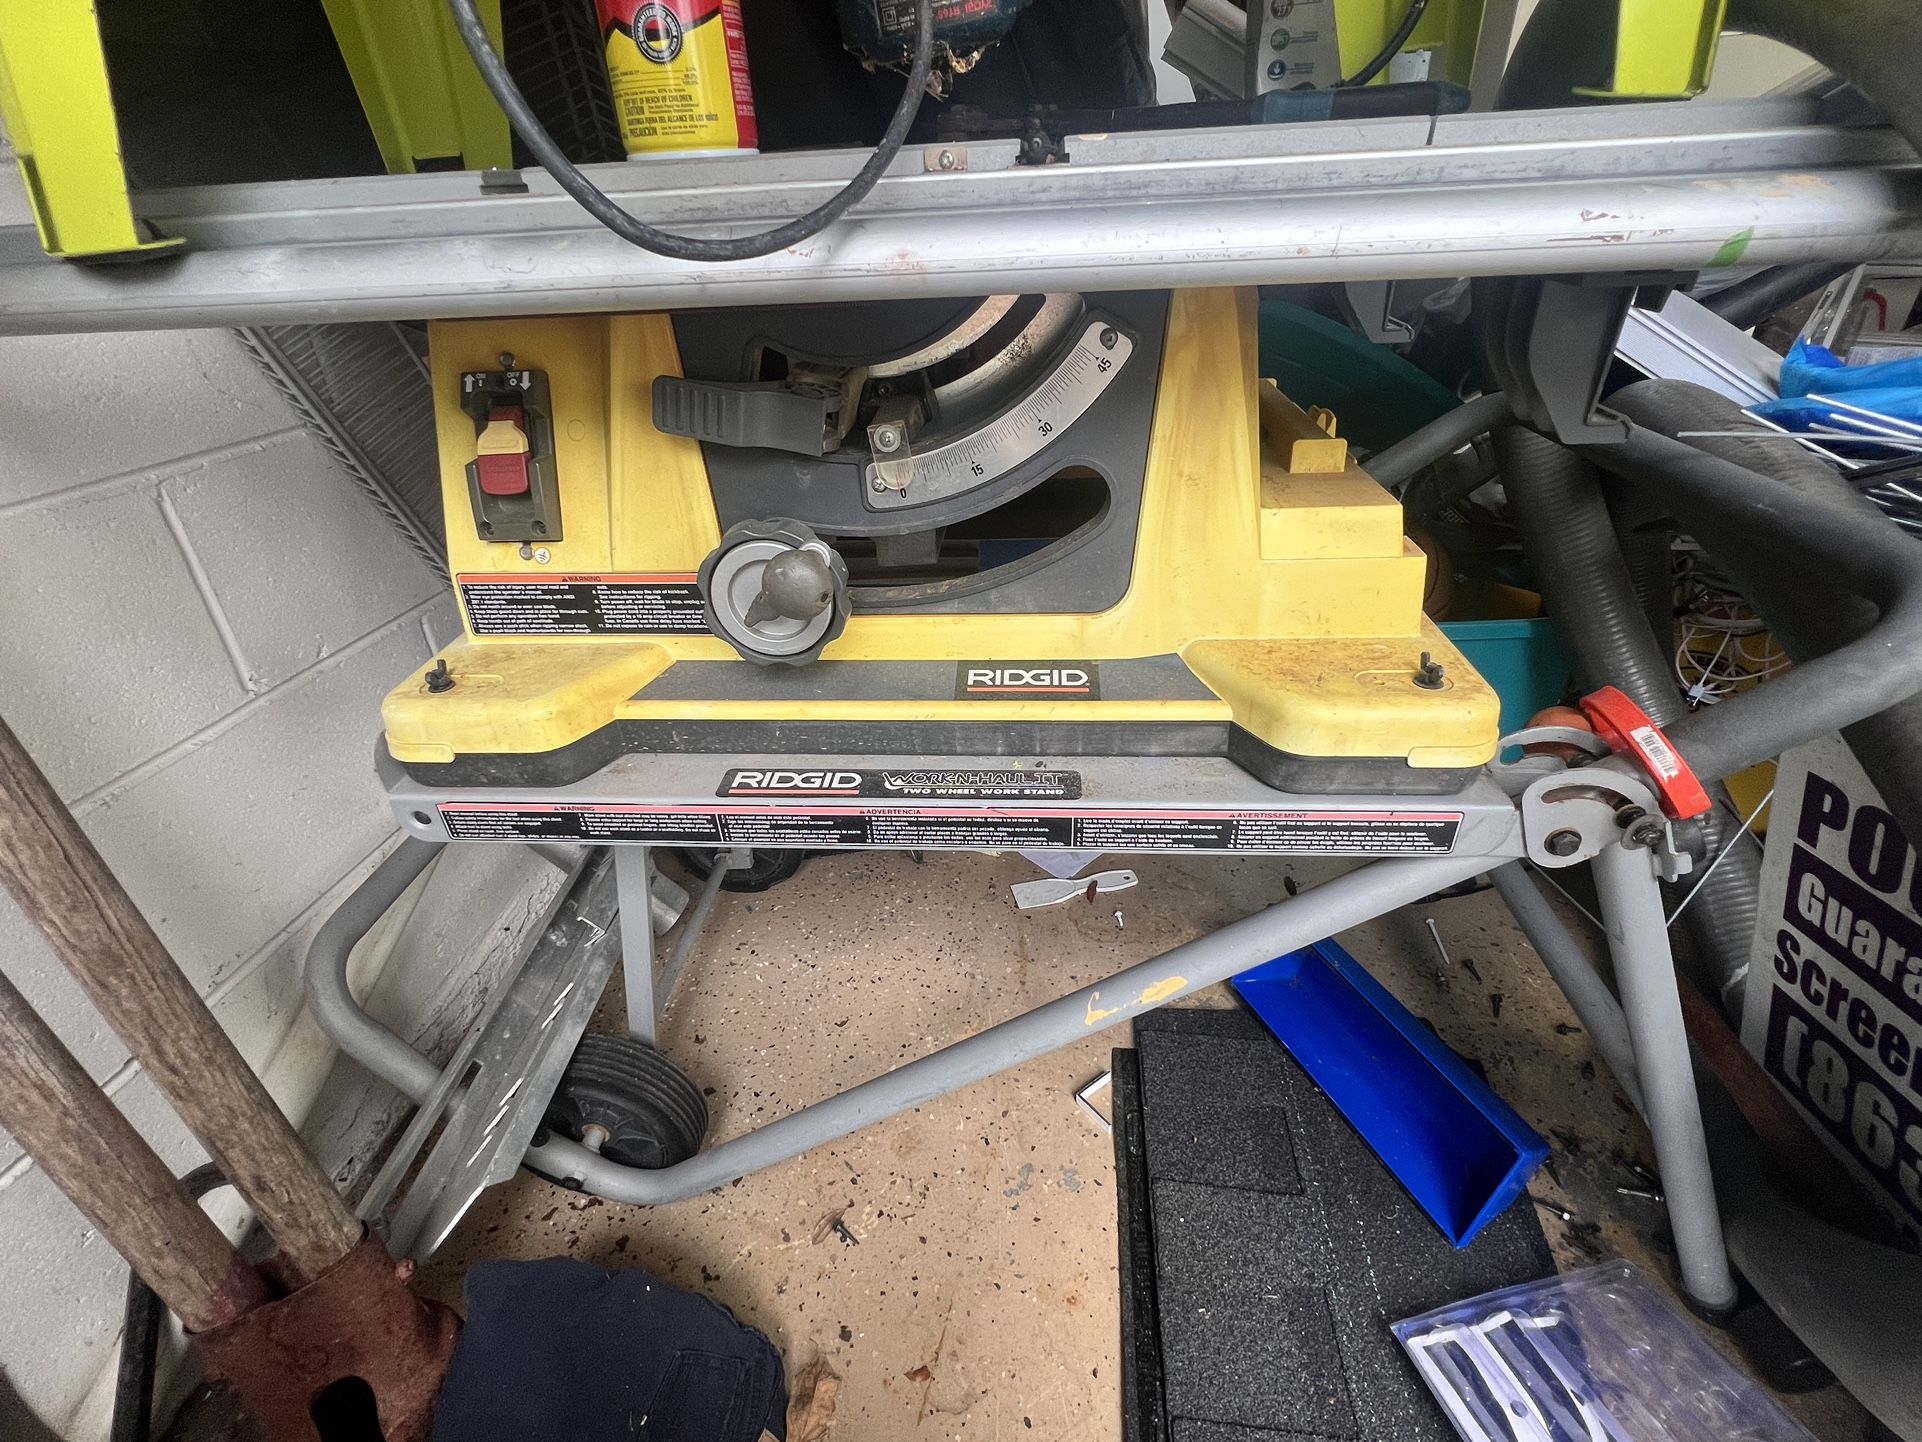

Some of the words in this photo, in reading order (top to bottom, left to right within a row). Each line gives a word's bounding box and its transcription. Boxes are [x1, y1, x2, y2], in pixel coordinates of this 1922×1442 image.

[1097, 357, 1112, 374] 45
[1038, 421, 1054, 437] 30
[971, 465, 984, 478] 15
[900, 488, 907, 499] 0
[967, 670, 1088, 686] RIDGID
[731, 771, 862, 788] RIDGID
